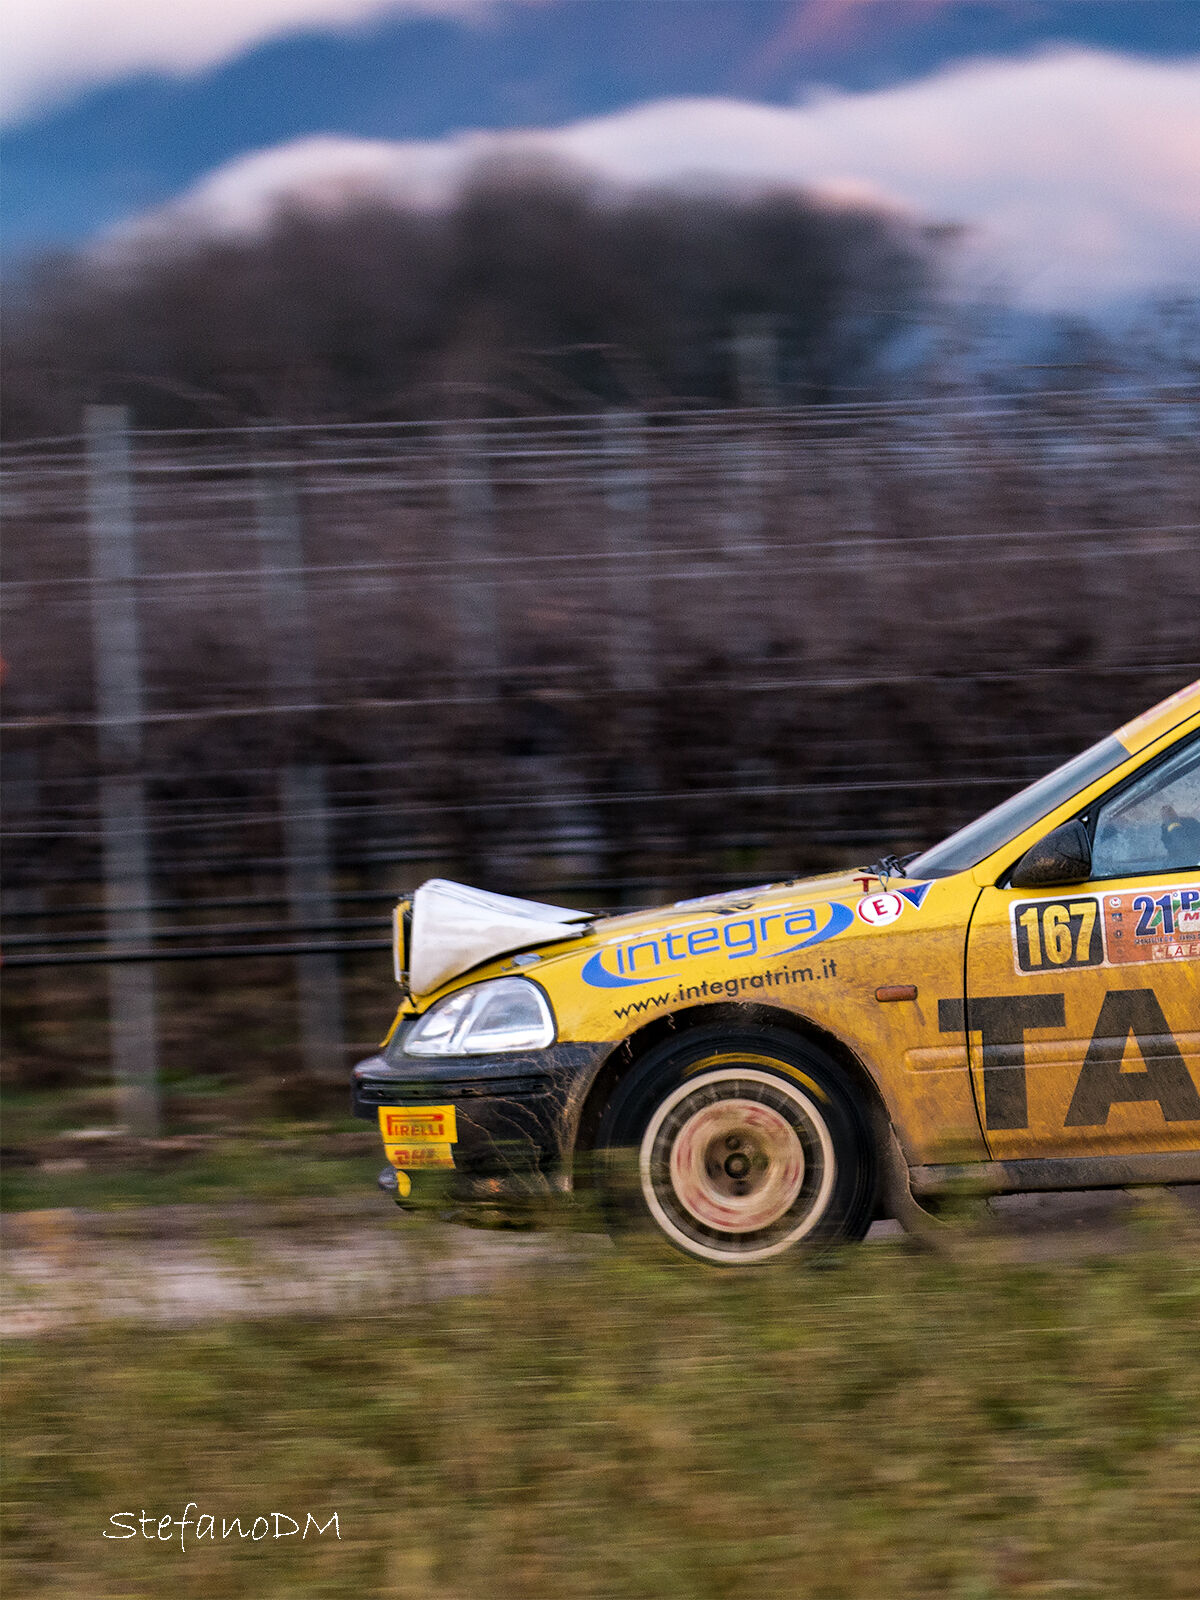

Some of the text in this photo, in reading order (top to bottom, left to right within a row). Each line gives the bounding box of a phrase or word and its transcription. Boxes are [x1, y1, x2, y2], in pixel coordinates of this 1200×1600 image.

[872, 899, 888, 916] E
[1019, 901, 1097, 967] 167
[616, 908, 818, 975] integra
[614, 958, 837, 1019] www.integratrim.it
[386, 1114, 445, 1136] PIRELLI
